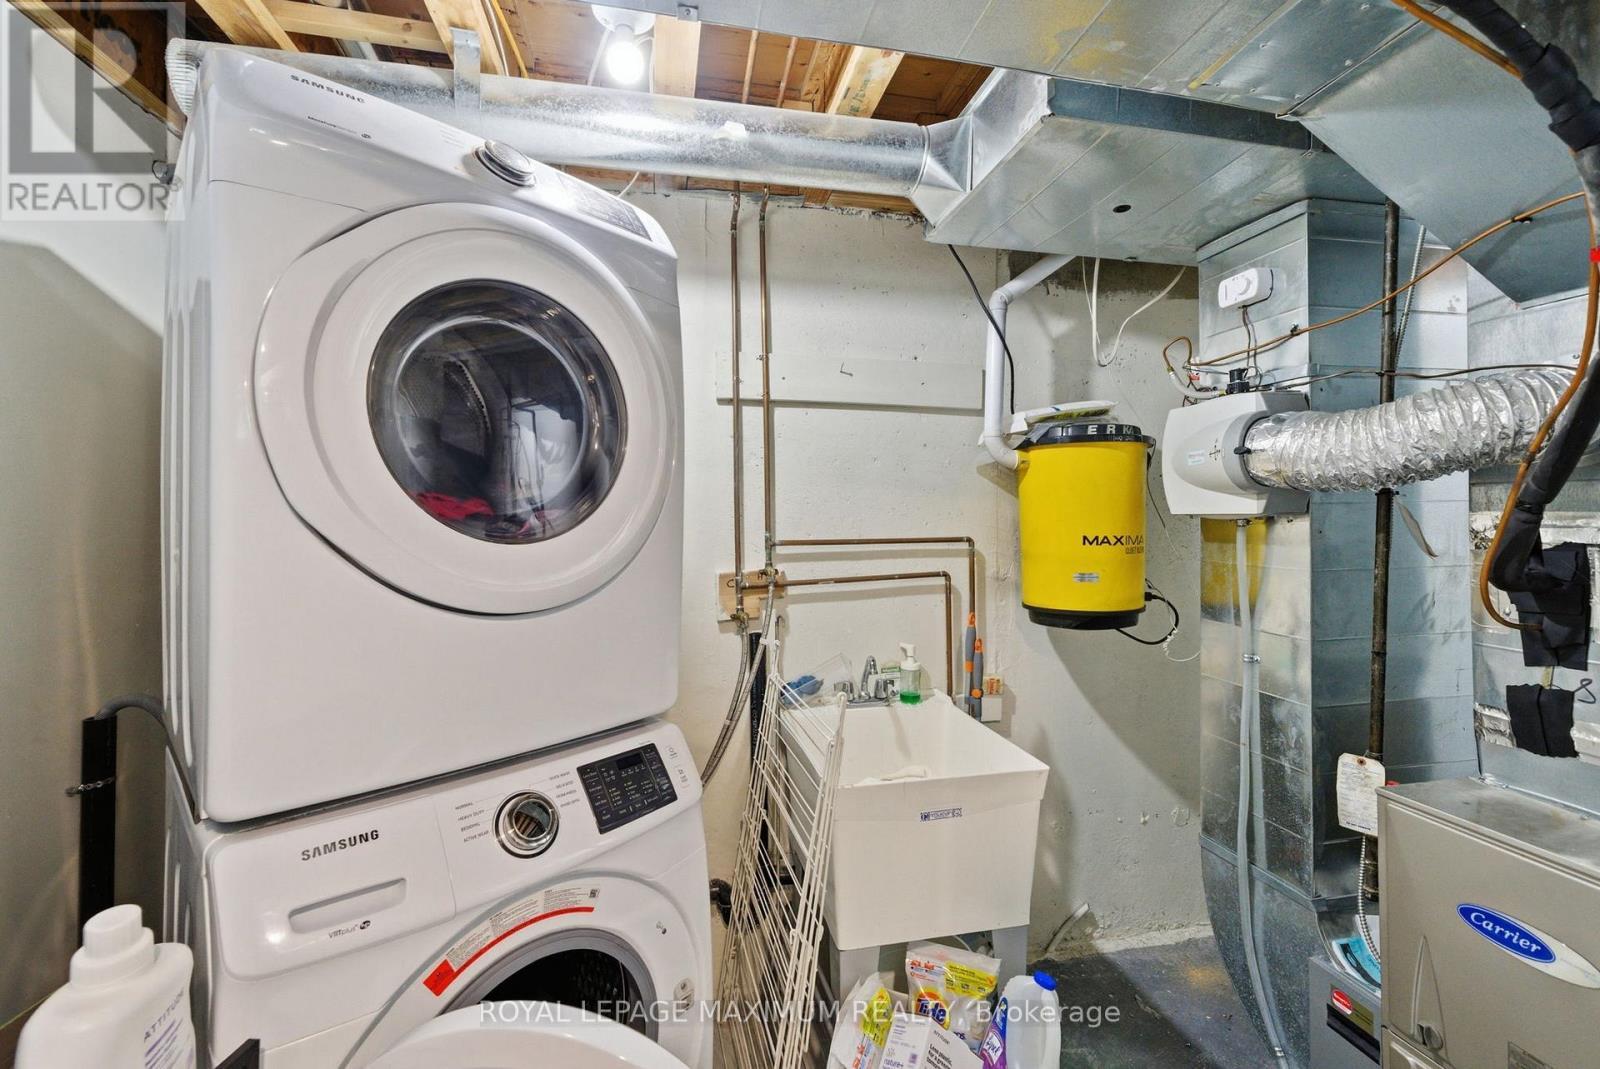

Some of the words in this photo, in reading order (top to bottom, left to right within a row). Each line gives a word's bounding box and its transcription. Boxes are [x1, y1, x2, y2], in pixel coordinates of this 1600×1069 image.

[301, 829, 379, 861] SAMSUNG
[1470, 912, 1541, 953] Carrier
[917, 998, 947, 1024] Tide
